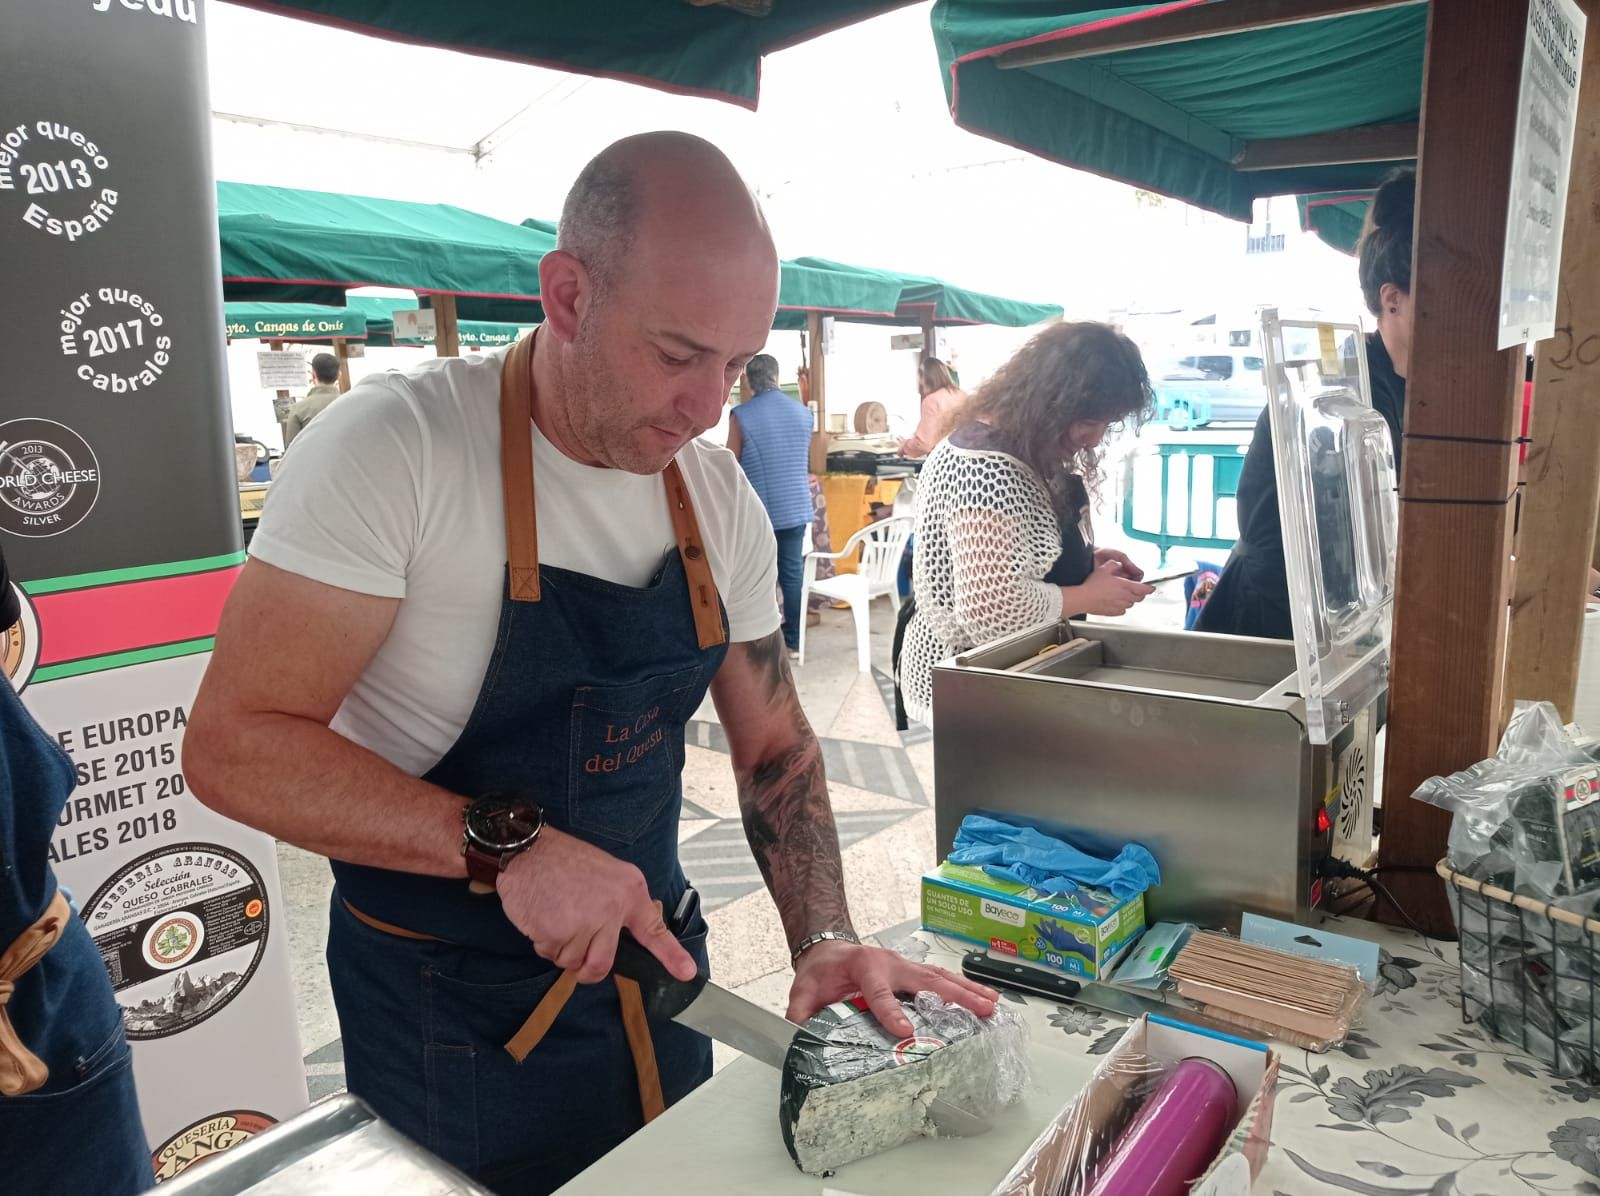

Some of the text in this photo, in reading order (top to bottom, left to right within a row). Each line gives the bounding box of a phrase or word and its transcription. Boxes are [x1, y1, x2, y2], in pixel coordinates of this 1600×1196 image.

[36, 120, 109, 170] queso
[19, 158, 92, 195] 2013
[22, 187, 119, 242] España
[60, 287, 163, 356] mejor queso
[225, 323, 250, 337] yto.
[254, 320, 299, 336] Cangas
[302, 319, 316, 332] de
[82, 318, 144, 357] 2017
[480, 332, 510, 345] Cangas
[21, 445, 43, 455] 2013
[41, 469, 97, 485] CHEESE
[12, 492, 65, 511] AWARDS
[23, 513, 62, 526] SILVER
[57, 706, 188, 754] E EUROPA
[605, 724, 630, 743] La
[76, 742, 175, 787] SE 2015
[585, 752, 622, 773] del
[57, 773, 186, 827] URMET 20
[47, 808, 177, 865] ALES 2018
[173, 855, 239, 879] ARANGAS
[122, 891, 158, 910] QUESO
[162, 874, 214, 896] CABRALES
[143, 870, 191, 893] Selección
[926, 889, 969, 907] GUANTES DE
[938, 900, 957, 912] SOLO
[957, 906, 973, 917] USO
[1051, 903, 1069, 912] 100
[984, 903, 1020, 921] Bayeco
[1046, 952, 1063, 965] 100
[163, 1118, 230, 1160] QUESERÍA
[155, 1131, 249, 1182] ANG
